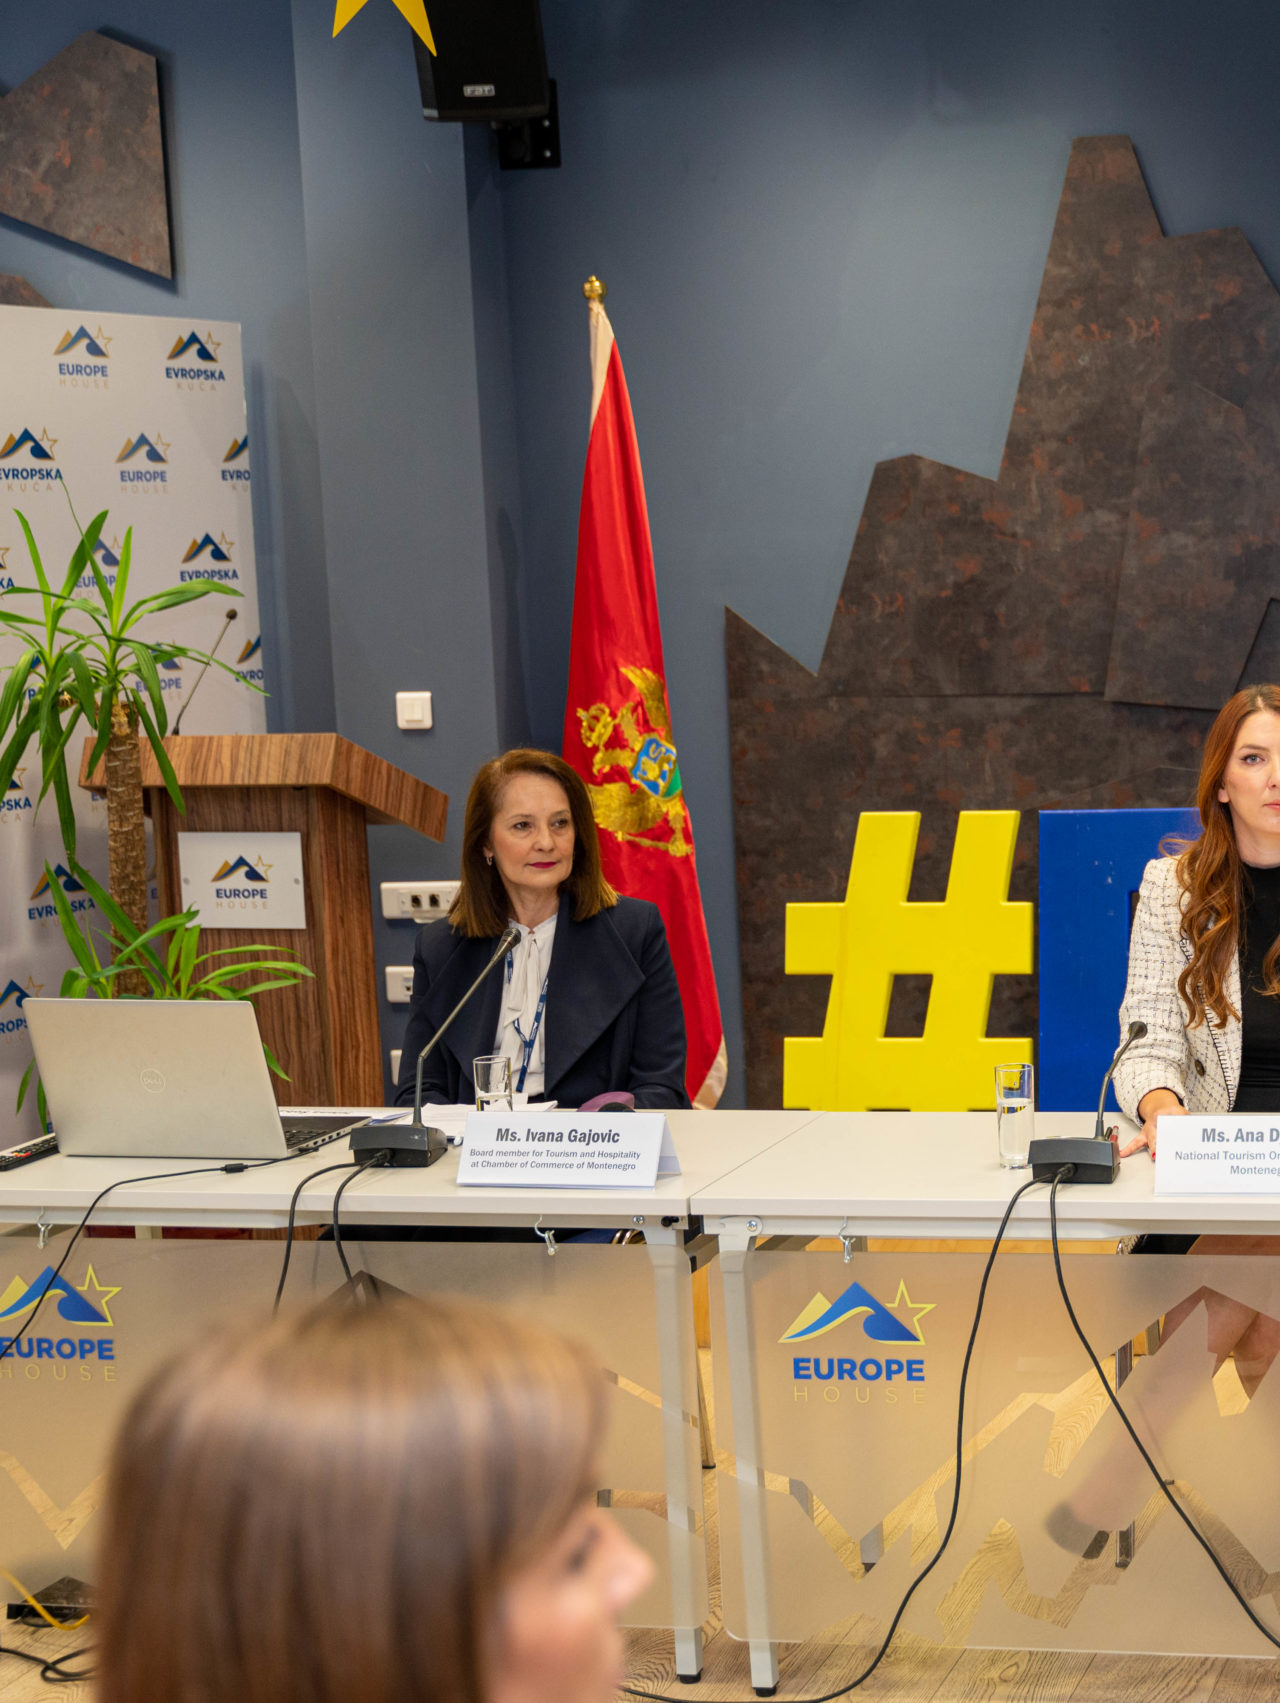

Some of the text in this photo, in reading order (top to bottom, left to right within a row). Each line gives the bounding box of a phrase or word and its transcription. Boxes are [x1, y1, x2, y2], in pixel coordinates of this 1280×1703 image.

[58, 363, 109, 377] EUROPE
[165, 367, 226, 382] EVROPSKA
[120, 470, 167, 483] EUROPE
[221, 470, 251, 482] EVRO
[179, 569, 239, 582] EVROPSKA
[135, 678, 182, 693] EOPE
[215, 888, 268, 899] EUROPE
[28, 897, 96, 920] EVRSKA
[496, 1128, 620, 1146] Ms. Ivana Gajovic
[1201, 1128, 1230, 1143] Ms.
[1234, 1128, 1264, 1143] Ana
[469, 1148, 641, 1160] Board member for Tourism and Hospitality
[1175, 1151, 1220, 1160] National
[1223, 1151, 1266, 1160] Tourism
[481, 1160, 518, 1169] Chamber
[520, 1160, 528, 1169] of
[530, 1161, 574, 1169] Commerce
[576, 1161, 585, 1169] of
[586, 1161, 636, 1172] Montenegro
[0, 1336, 115, 1360] EUROPE
[0, 1363, 117, 1382] HOUSE
[793, 1357, 926, 1382] EUROPE
[793, 1385, 926, 1404] HOUSE
